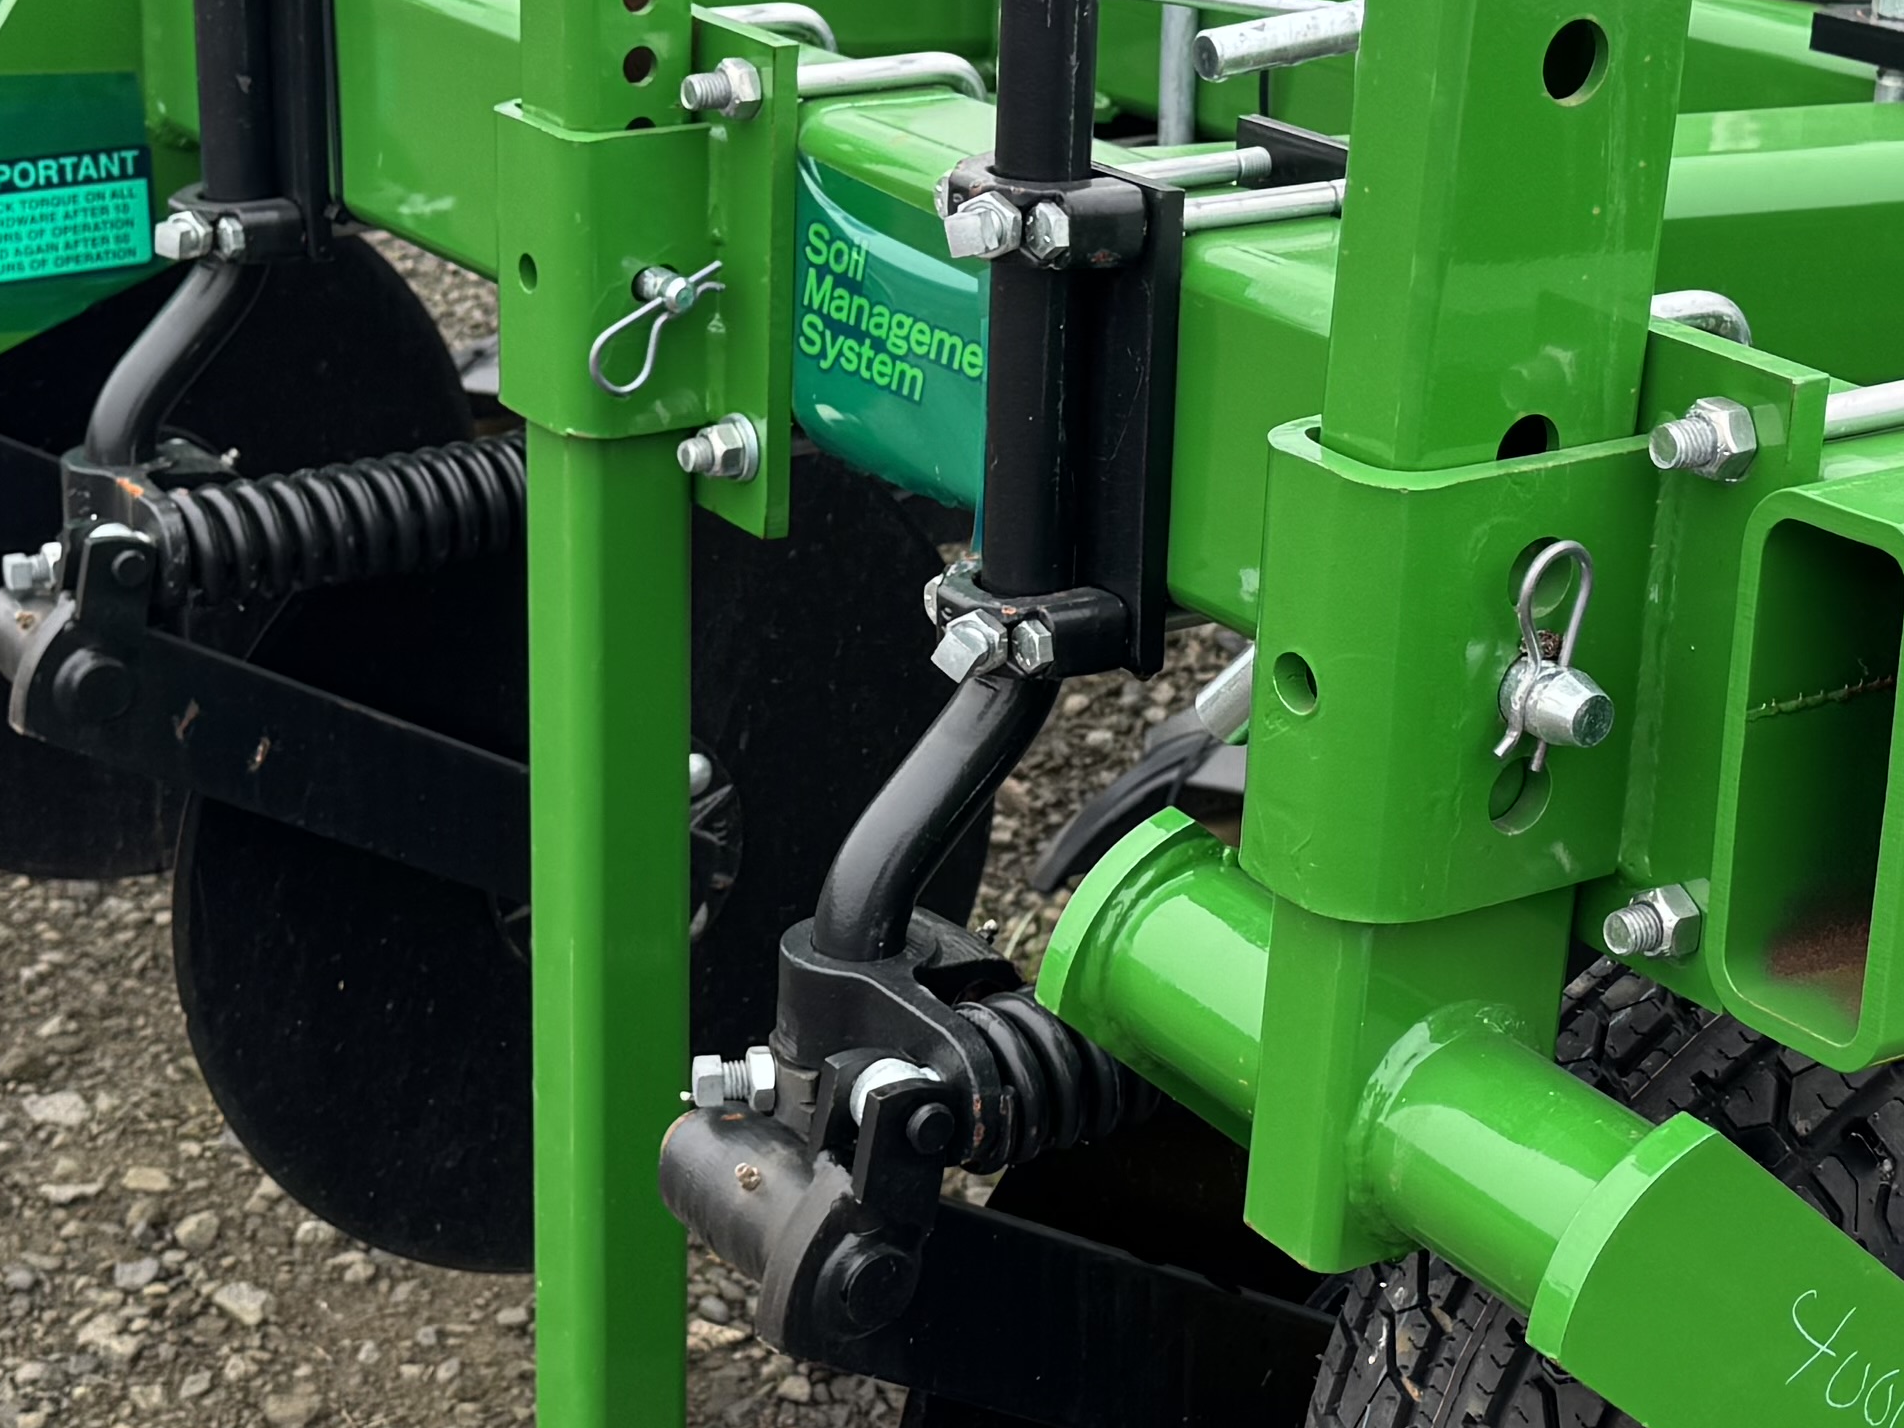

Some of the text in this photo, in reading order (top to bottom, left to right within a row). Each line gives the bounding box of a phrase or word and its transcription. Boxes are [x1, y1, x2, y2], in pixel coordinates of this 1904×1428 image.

[19, 194, 79, 212] TORQUE
[85, 190, 107, 204] ON
[111, 186, 136, 200] ALL
[63, 204, 110, 222] AFTER
[27, 228, 44, 242] OF
[51, 218, 135, 240] OPERATION
[14, 242, 60, 258] AGAIN
[64, 235, 110, 252] AFTER
[805, 222, 869, 281] Soil
[29, 257, 48, 272] OF
[53, 247, 138, 270] OPERATION
[803, 268, 983, 378] Manageme
[799, 313, 924, 402] System
